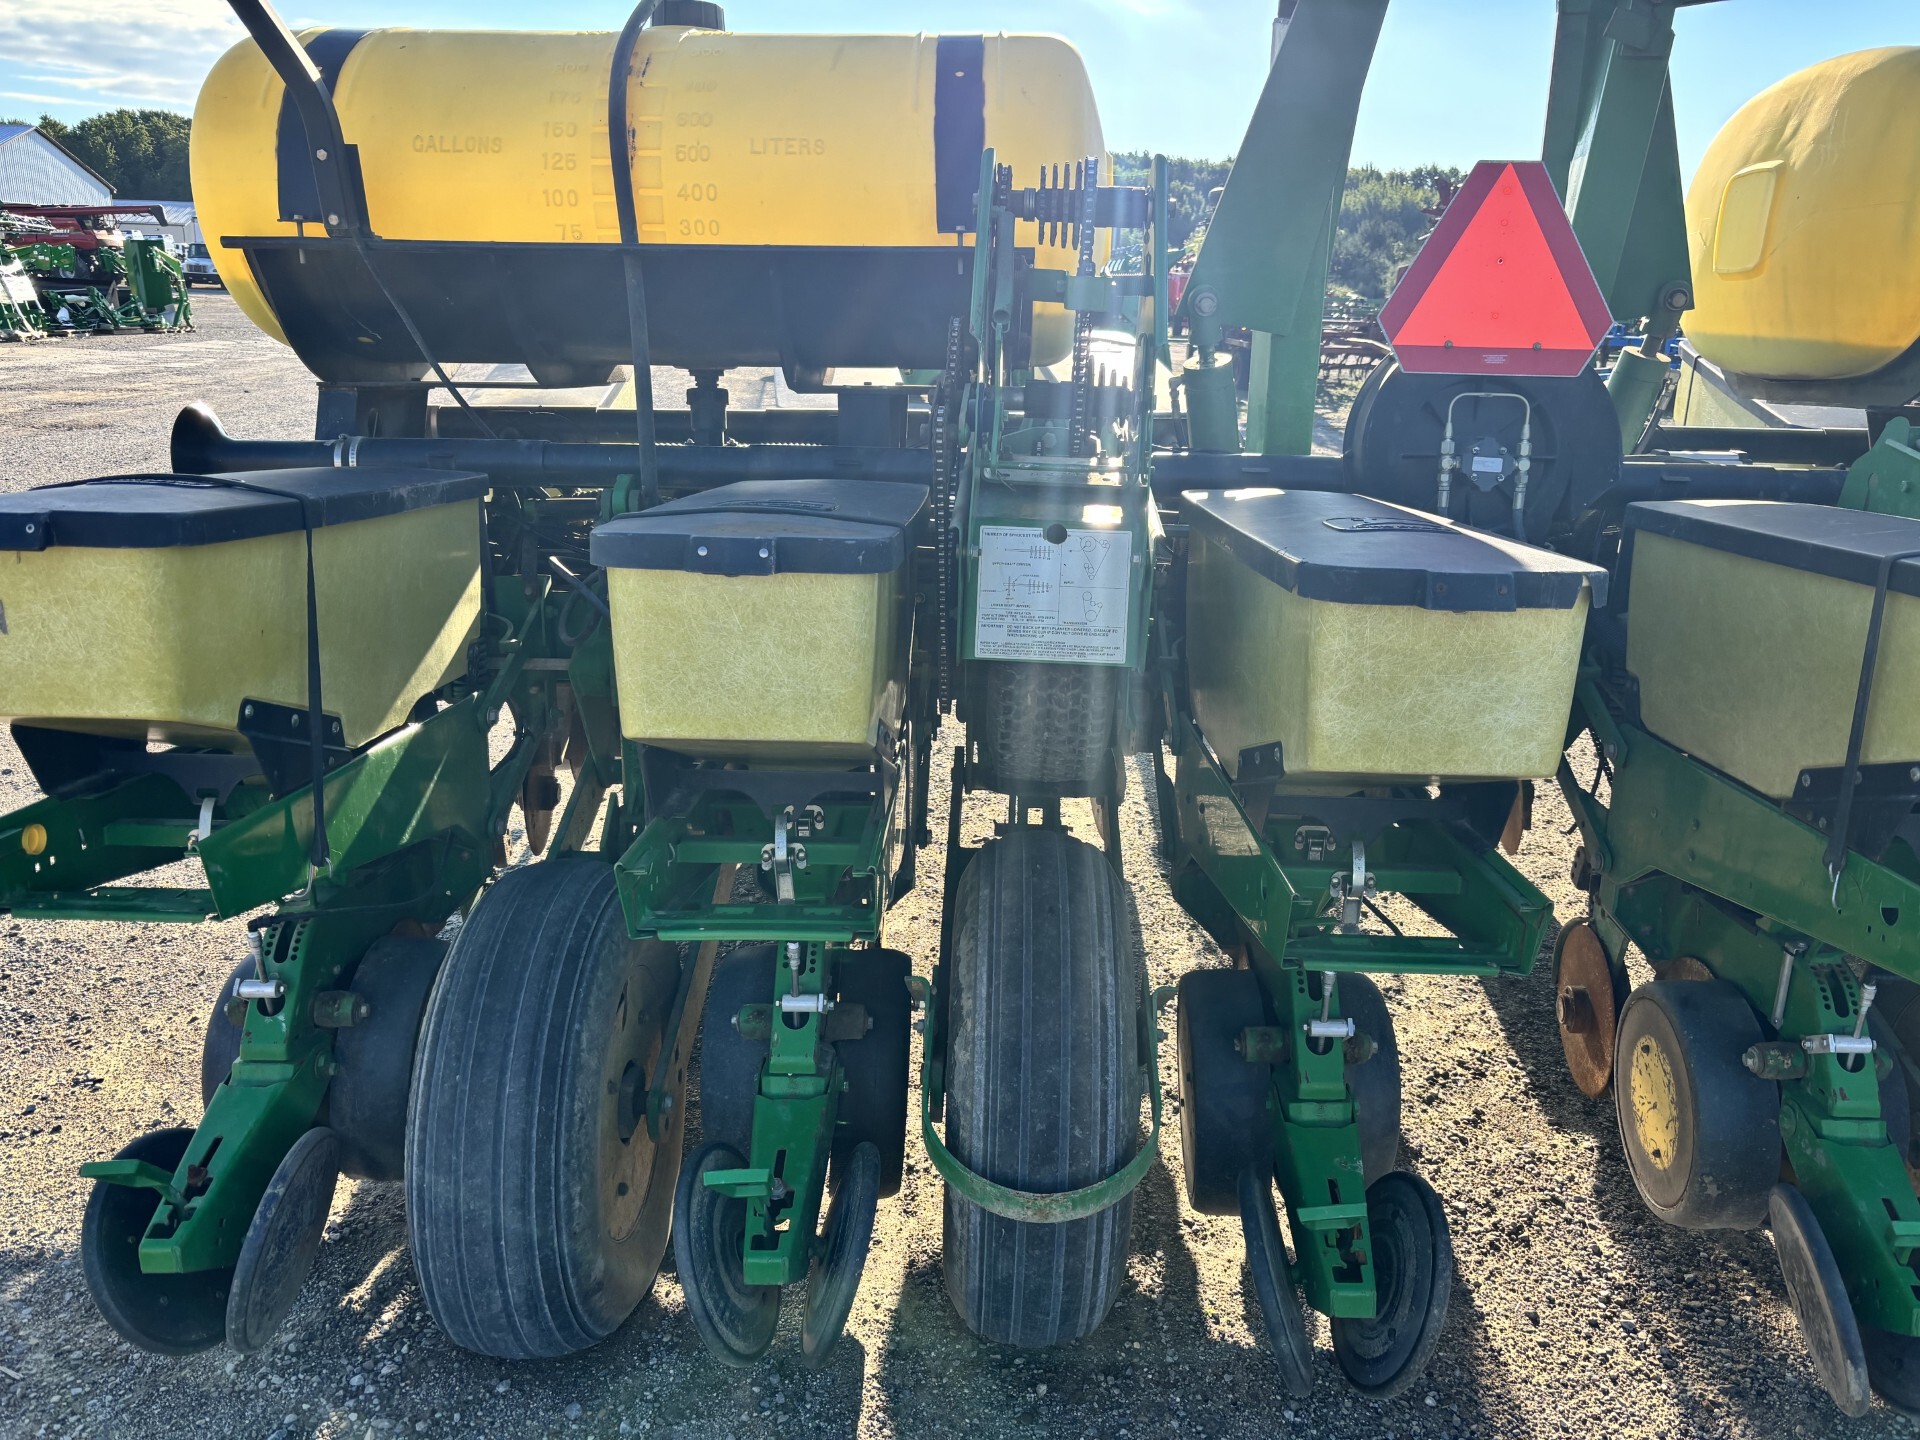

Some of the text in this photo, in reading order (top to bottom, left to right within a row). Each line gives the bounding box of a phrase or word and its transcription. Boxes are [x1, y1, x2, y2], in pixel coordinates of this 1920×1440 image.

[676, 111, 713, 128] 600
[412, 134, 503, 154] GALLONS
[675, 144, 711, 162] 500
[750, 137, 826, 156] LITERS
[542, 152, 577, 170] 125
[542, 188, 579, 207] 100
[676, 183, 718, 202] 400
[554, 224, 583, 241] 75
[679, 219, 720, 236] 300
